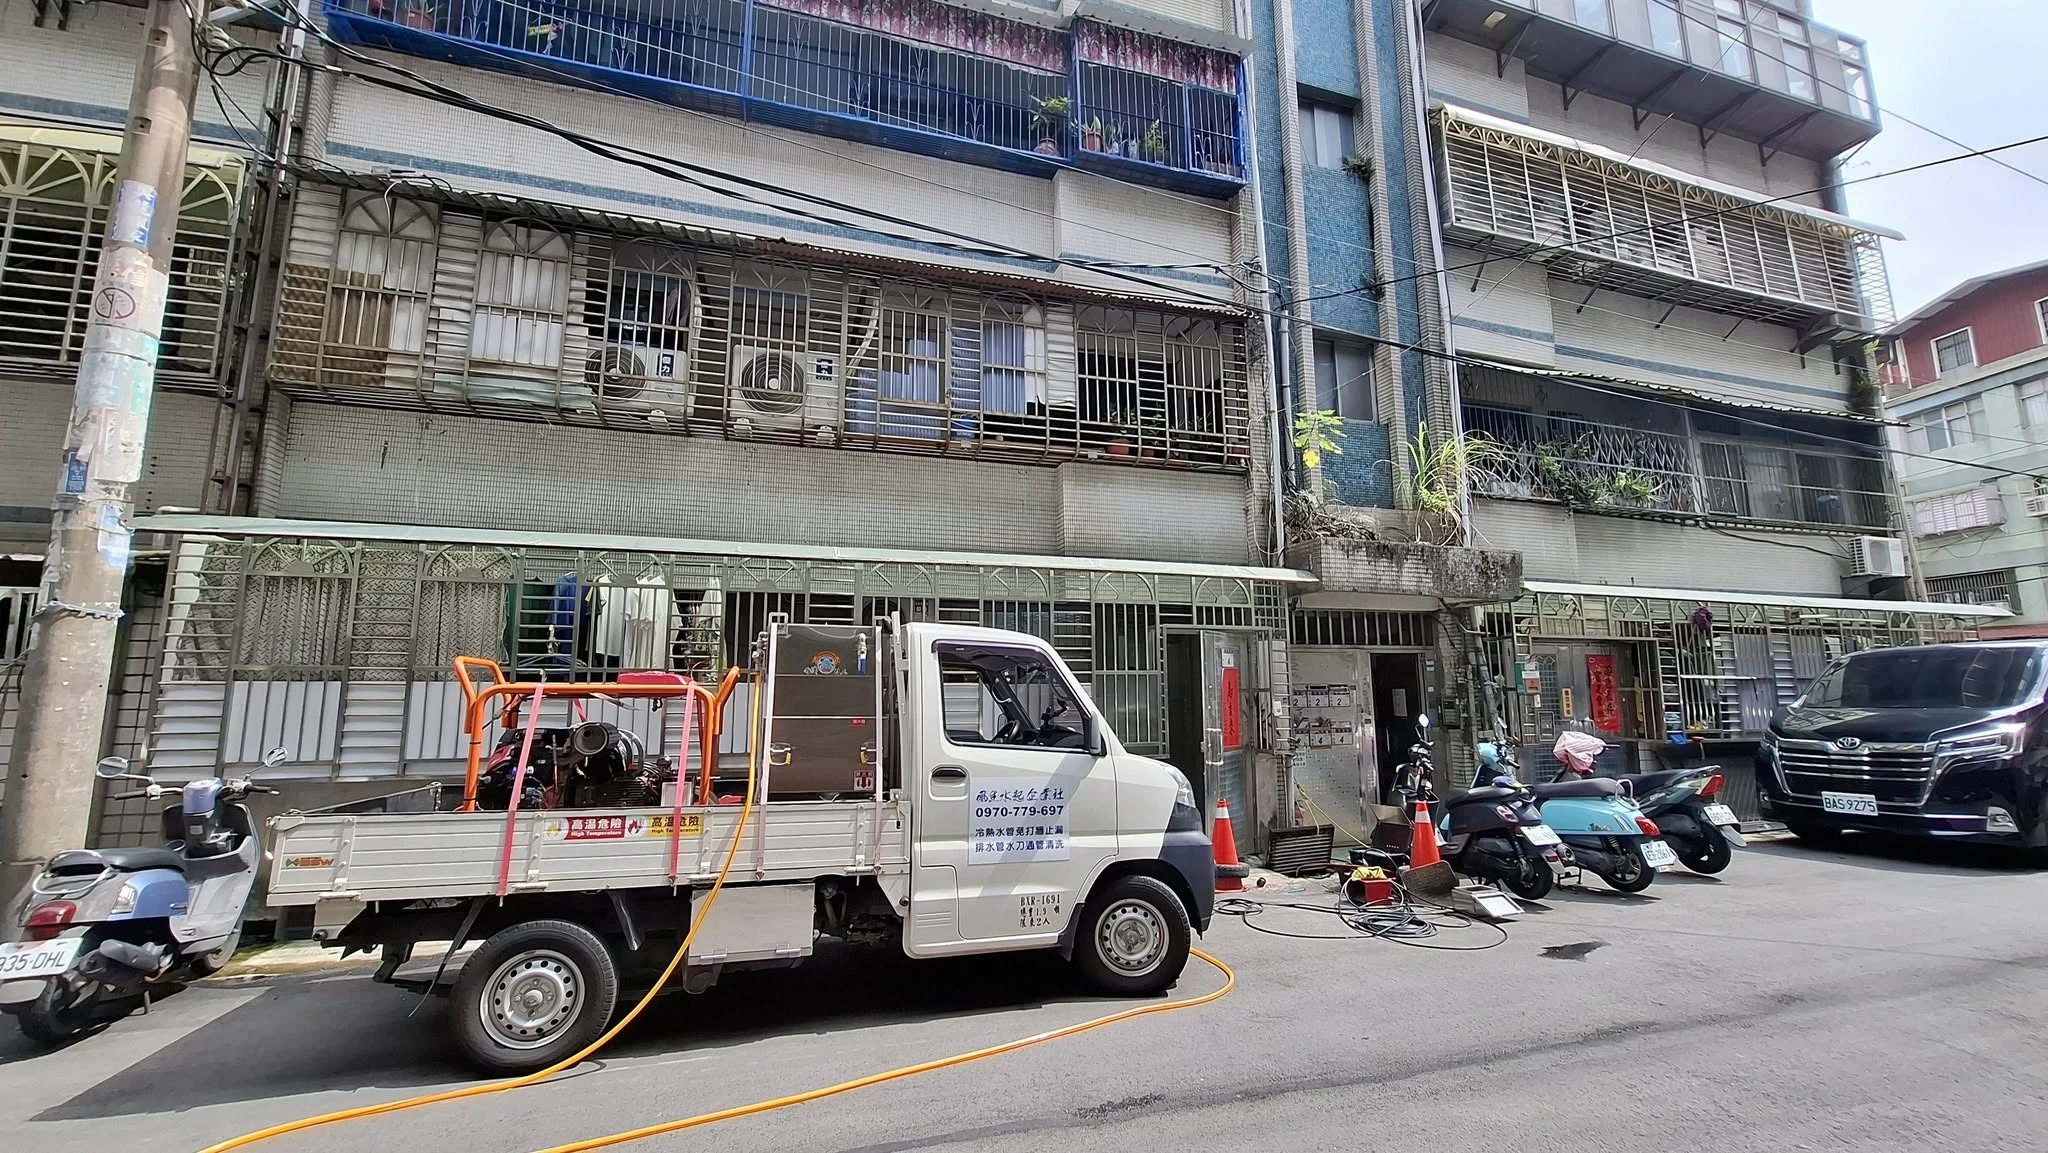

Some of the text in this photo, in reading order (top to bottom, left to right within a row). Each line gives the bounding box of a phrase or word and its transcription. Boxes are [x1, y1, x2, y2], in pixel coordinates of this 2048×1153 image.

[975, 805, 1064, 818] 0970-779-697
[571, 818, 622, 830] 高溫危險
[1020, 894, 1060, 907] BXR-1691
